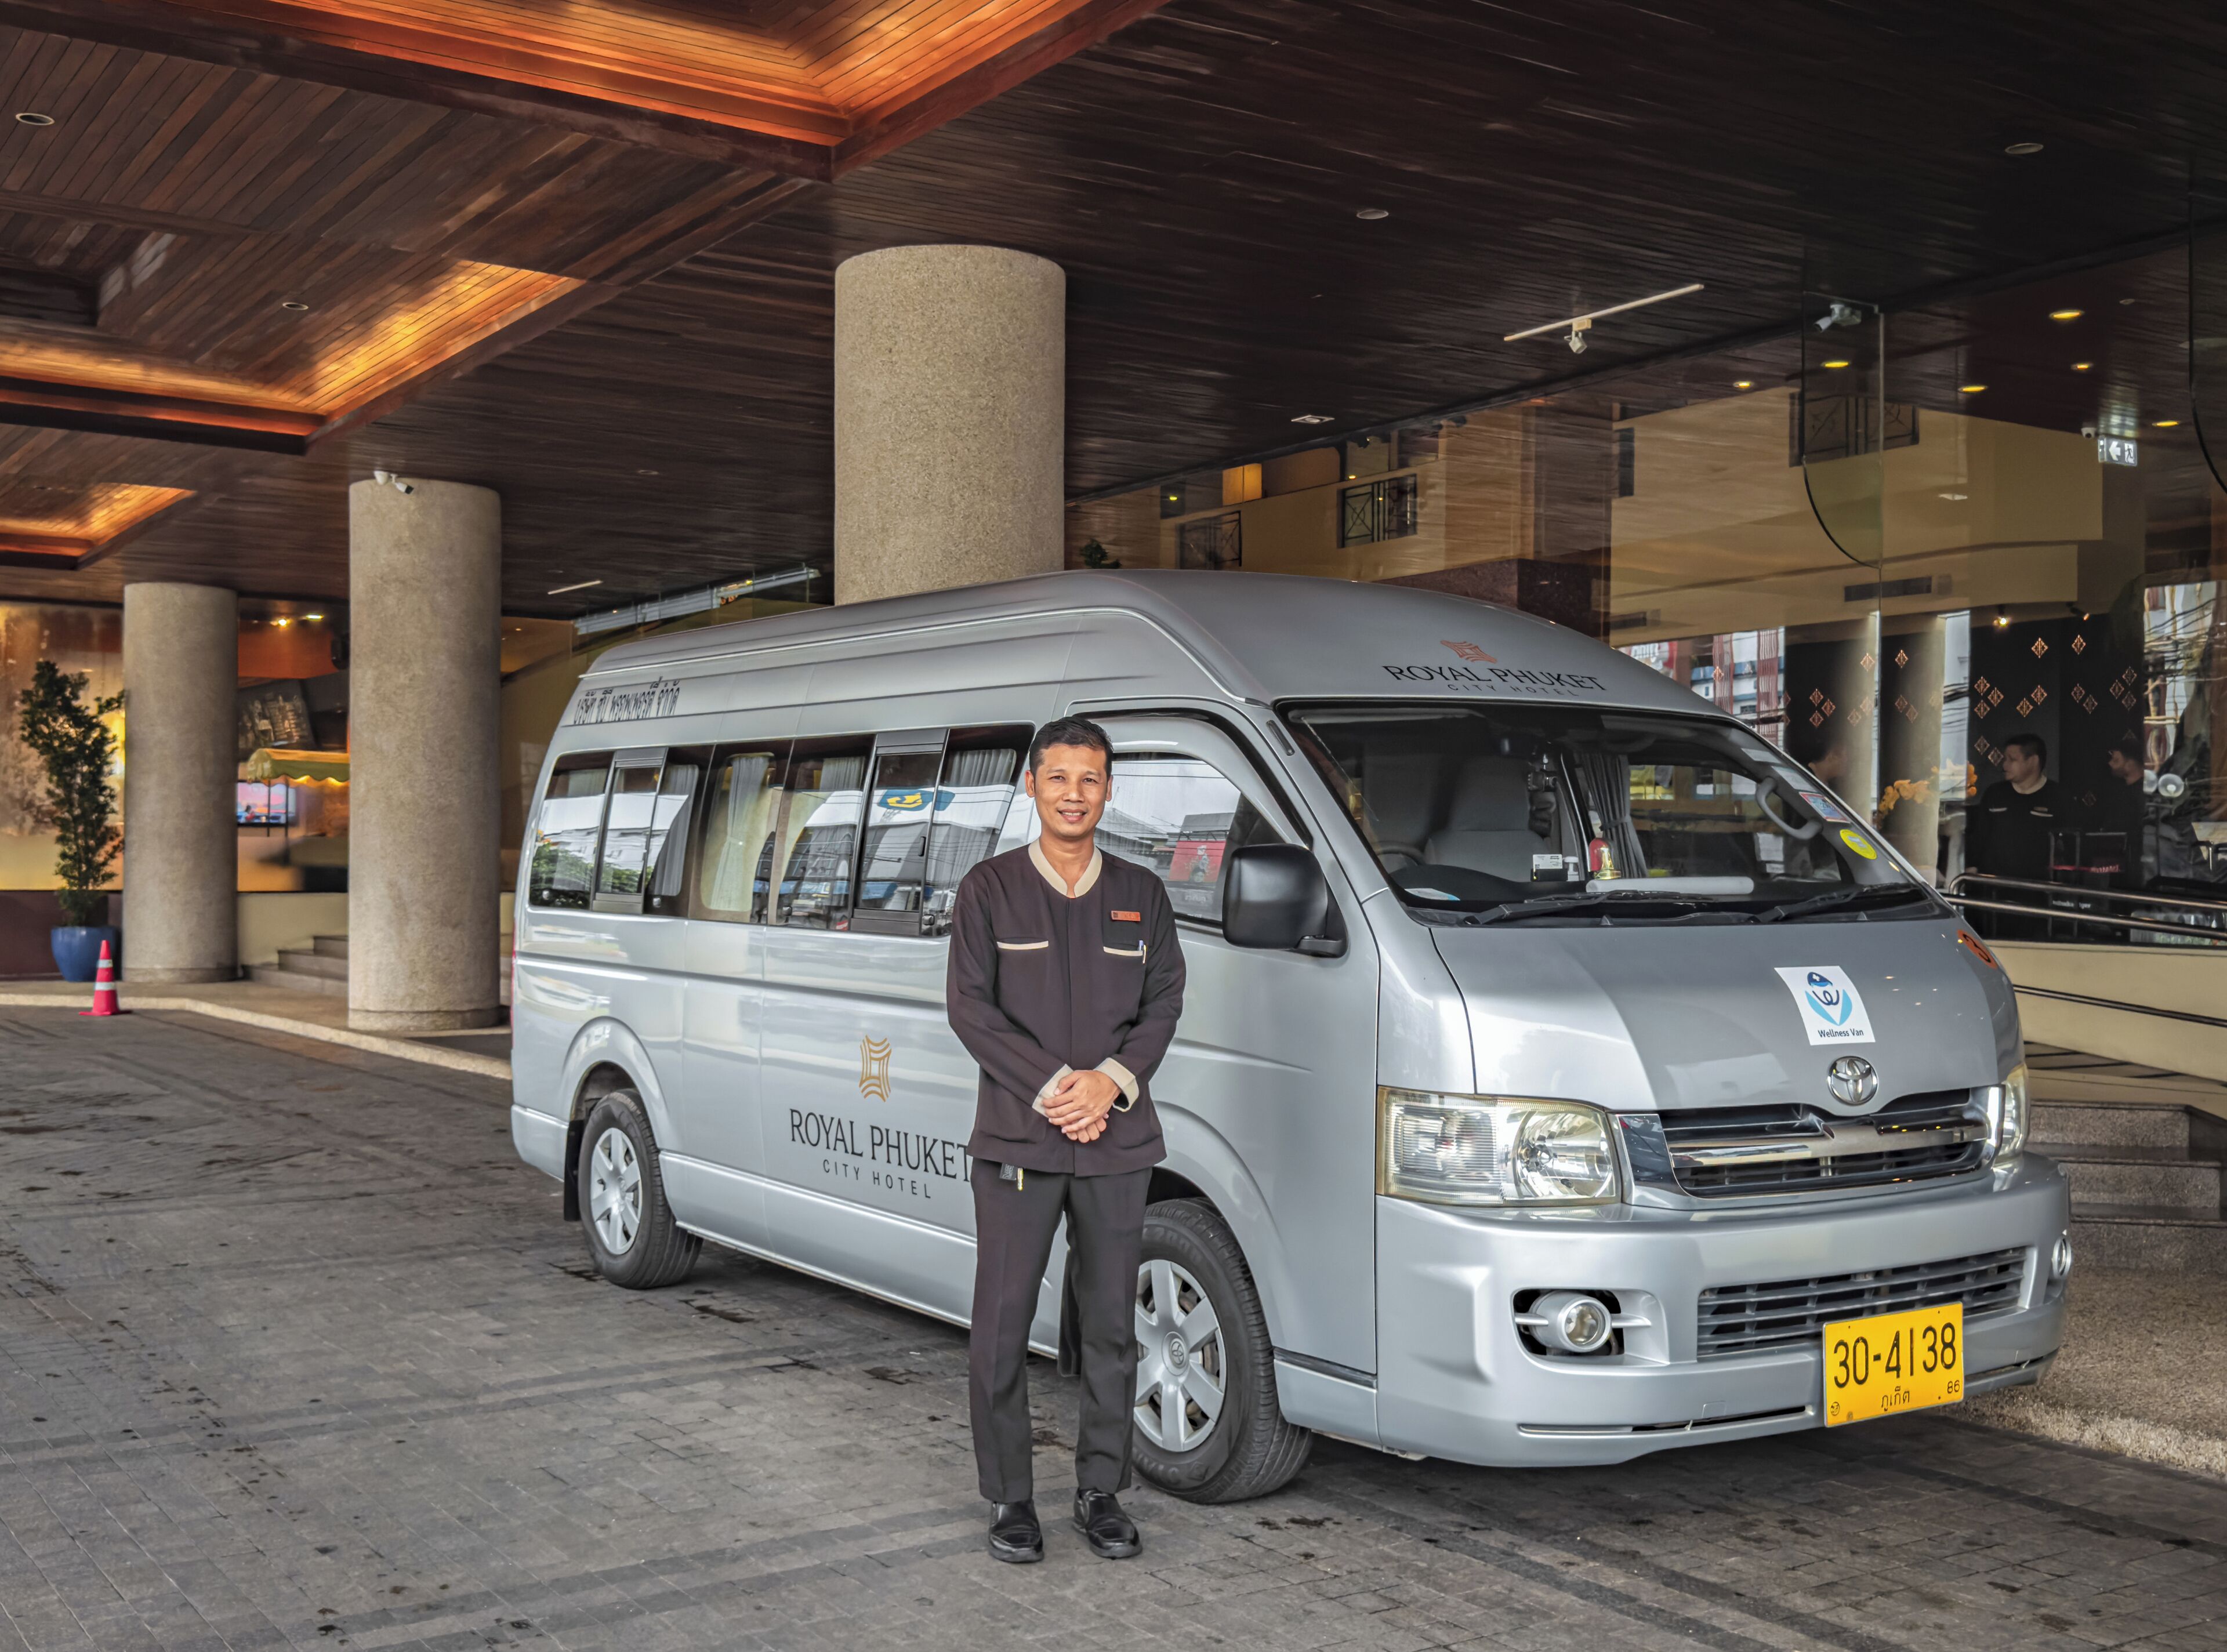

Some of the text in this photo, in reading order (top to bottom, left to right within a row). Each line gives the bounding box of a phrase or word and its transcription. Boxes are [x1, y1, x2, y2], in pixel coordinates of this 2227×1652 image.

[1383, 665, 1606, 691] ROYAL PHUKET
[1447, 684, 1579, 696] CITY HOTEL
[1818, 1028, 1864, 1038] Wellness Van
[789, 1108, 971, 1182] ROYAL PHUKET
[823, 1159, 931, 1199] CITY HOTEL
[1833, 1321, 1956, 1388] 30-4138
[1881, 1385, 1910, 1411] ภูเก็ต
